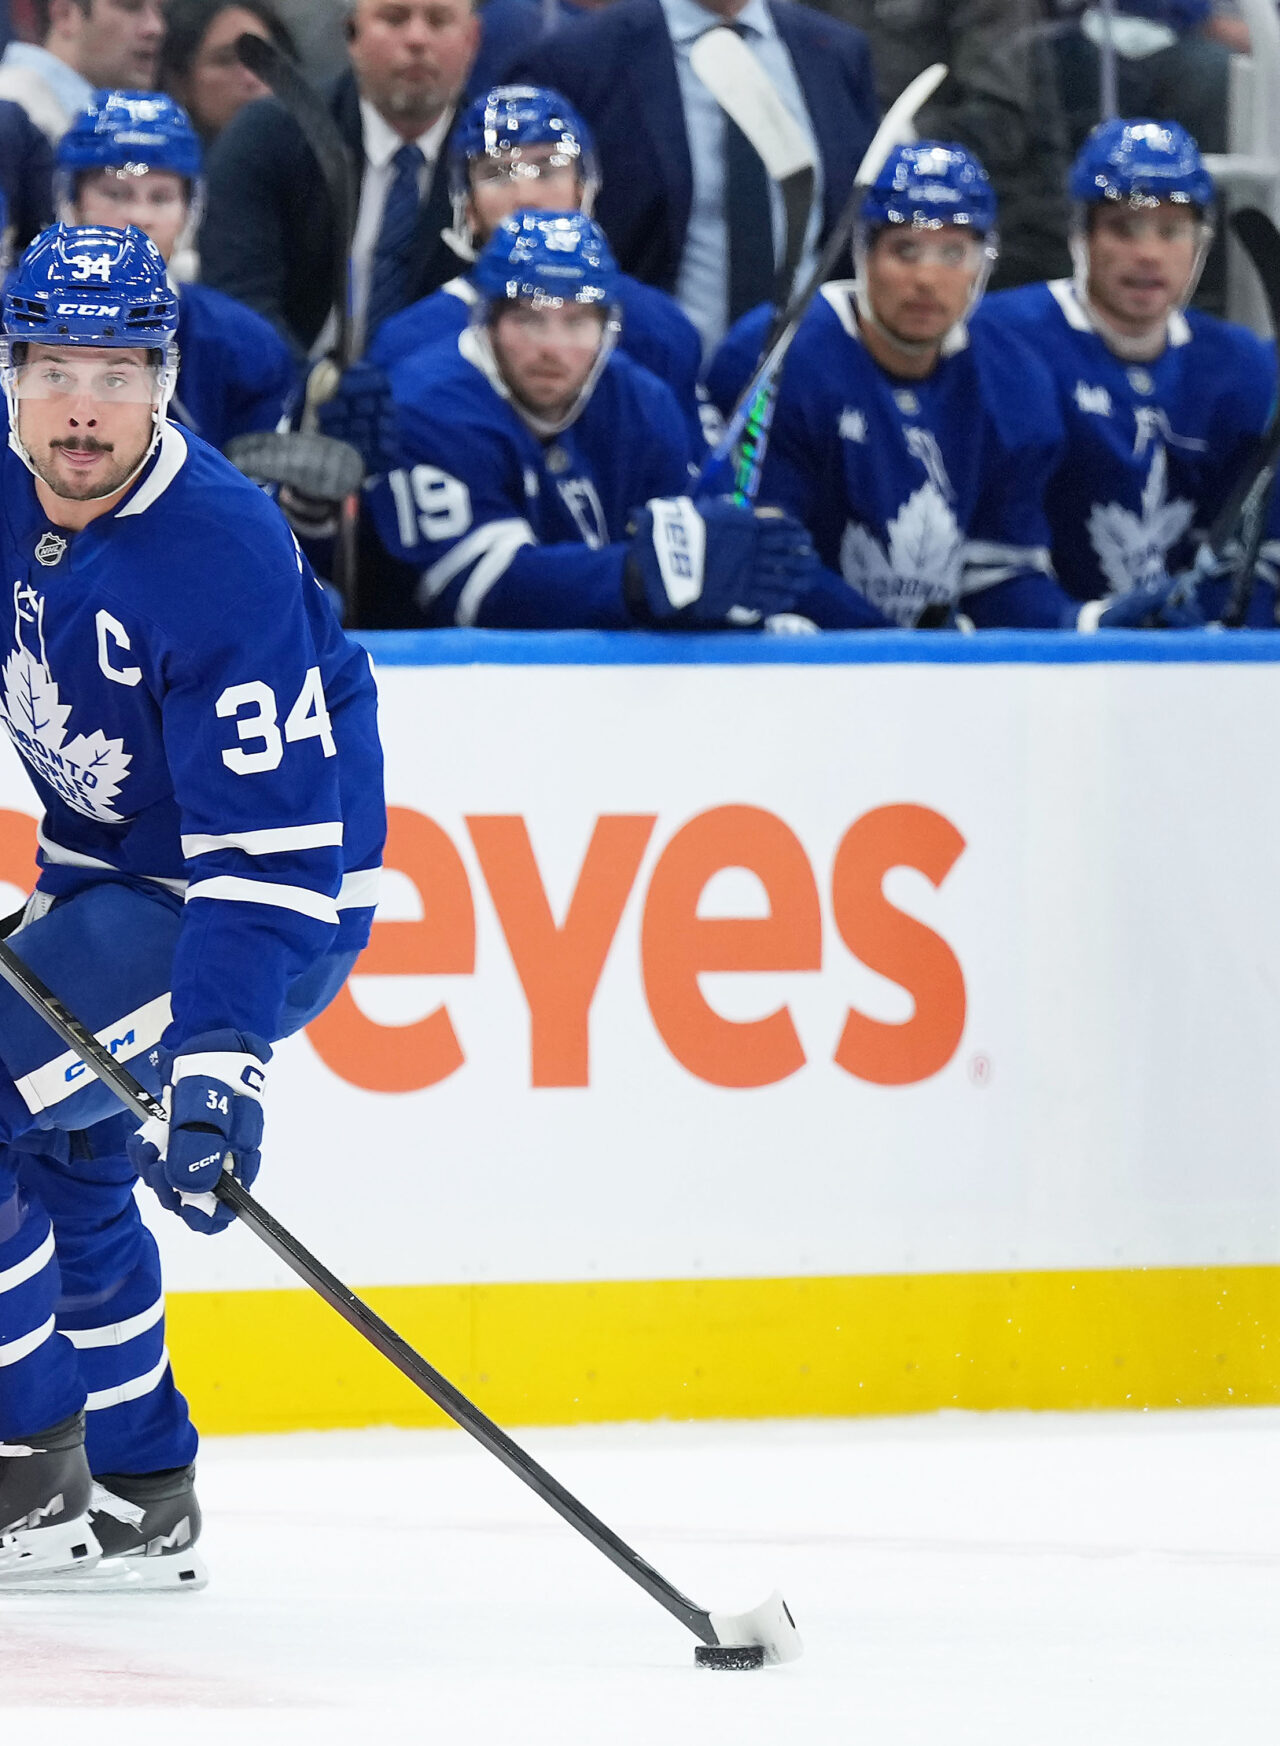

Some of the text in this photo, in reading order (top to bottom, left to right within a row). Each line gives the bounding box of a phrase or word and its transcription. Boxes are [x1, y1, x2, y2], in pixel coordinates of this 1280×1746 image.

[71, 254, 111, 282] 34
[56, 303, 120, 317] CCM
[388, 463, 473, 548] 19
[95, 609, 142, 687] C
[215, 666, 337, 775] 34
[64, 1028, 135, 1082] CM
[206, 1089, 229, 1115] 34
[188, 1151, 221, 1173] CCM
